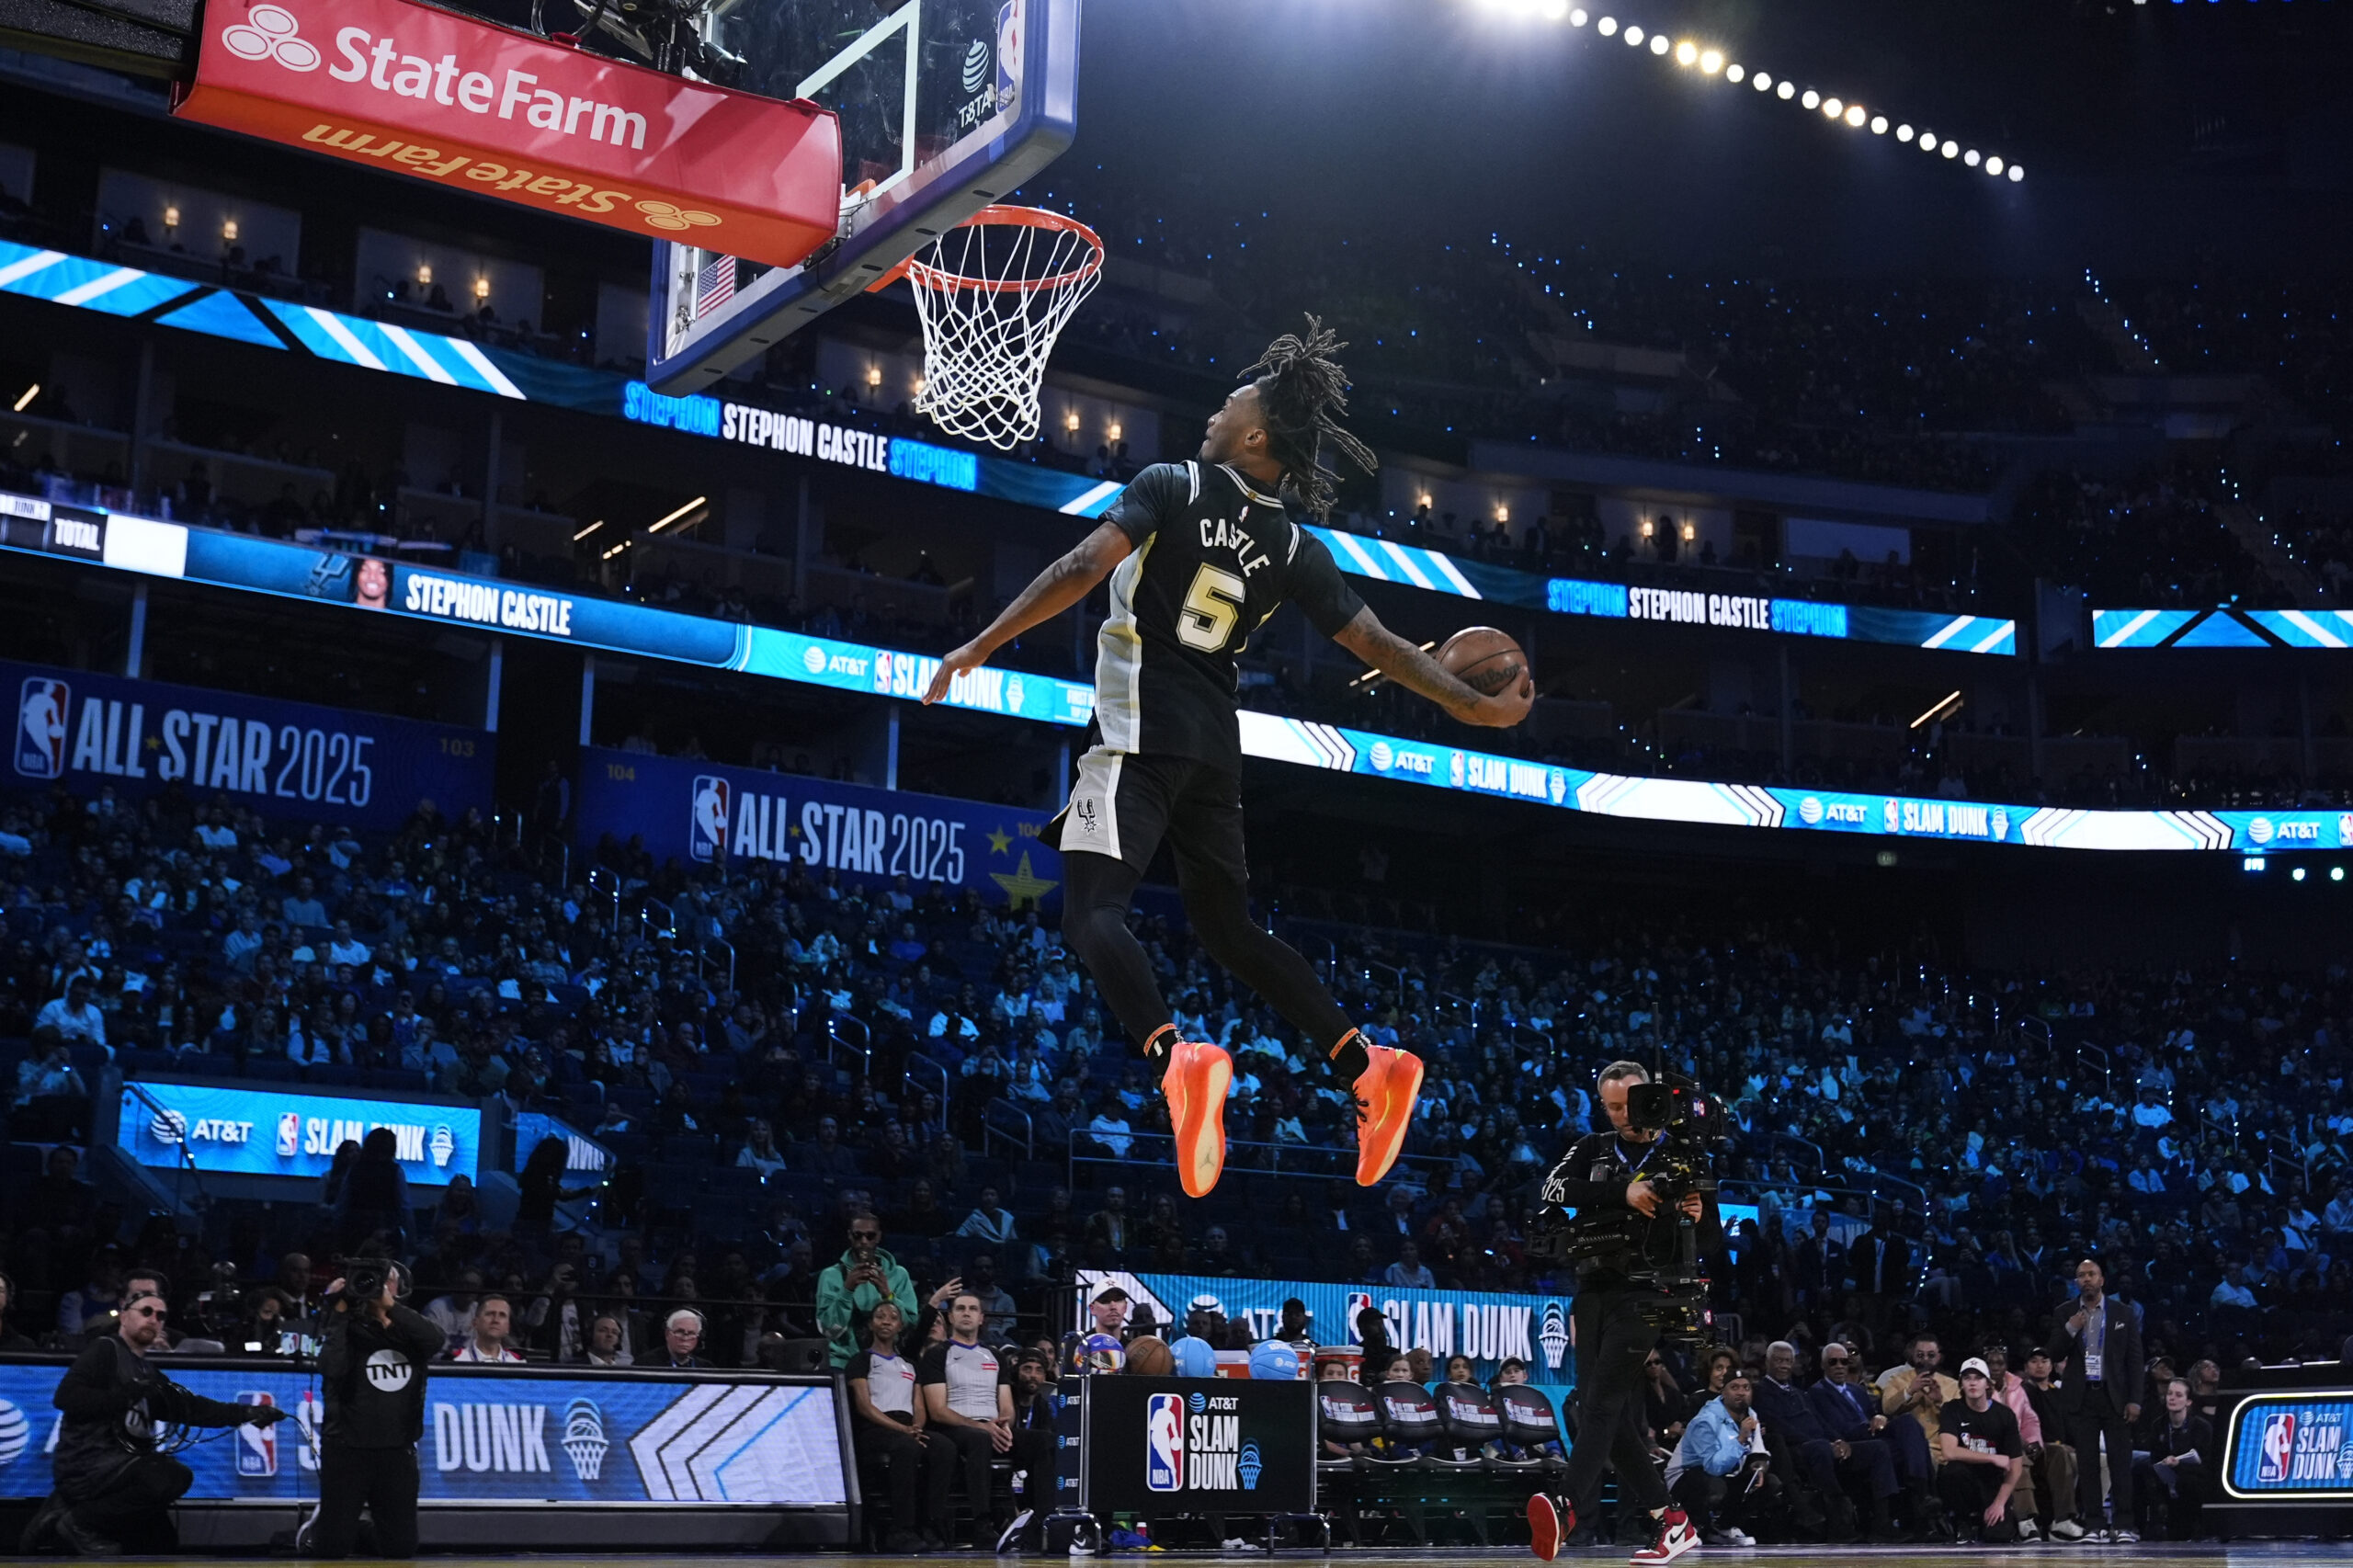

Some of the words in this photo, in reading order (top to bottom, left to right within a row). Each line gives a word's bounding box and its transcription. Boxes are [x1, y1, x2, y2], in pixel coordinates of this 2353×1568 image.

[624, 381, 720, 437] STEPHON
[722, 403, 814, 456] STEPHON
[817, 423, 887, 472] CASTLE
[890, 437, 977, 491] STEPHON
[55, 517, 100, 551] TOTAL
[1199, 518, 1270, 578] CASTLE
[405, 574, 499, 623] STEPHON
[501, 590, 573, 635] CASTLE
[1176, 562, 1246, 653] 5
[1548, 578, 1627, 618] STEPHON
[1630, 586, 1706, 624] STEPHON
[1709, 595, 1769, 630] CASTLE
[1771, 599, 1847, 638] STEPHON
[829, 654, 869, 676] AT&T
[892, 654, 949, 701] SLA
[72, 697, 146, 778] ALL
[159, 709, 271, 794] STAR
[276, 724, 374, 808] 2025
[439, 737, 475, 757] 103
[607, 764, 636, 781] 104
[1394, 751, 1436, 774] AT&T
[1468, 756, 1506, 791] SLAM
[1510, 763, 1548, 799] DUNK
[1825, 803, 1868, 823] AT&T
[1903, 801, 1945, 834] SLAM
[1948, 806, 1989, 836] DUNK
[2277, 822, 2320, 839] AT&T
[734, 792, 790, 862] ALL
[799, 801, 884, 874] STAR
[891, 812, 966, 884] 2025
[191, 1119, 254, 1142] AT&T
[370, 1121, 426, 1162] NK
[1381, 1300, 1454, 1359] SLAM
[1464, 1302, 1533, 1361] DUNK
[368, 1363, 411, 1381] TNT
[1067, 1396, 1081, 1405] AT&T
[1208, 1397, 1239, 1410] AT&T
[1189, 1415, 1239, 1452] SLAM
[2315, 1413, 2343, 1424] AT&T
[433, 1403, 551, 1472] DUNK
[1066, 1437, 1080, 1446] AT&T
[2295, 1426, 2342, 1453] SLAM
[1065, 1478, 1079, 1487] AT&T
[1153, 1469, 1170, 1484] NBA
[1188, 1453, 1239, 1490] DUNK
[2261, 1466, 2276, 1477] NBA
[2292, 1452, 2338, 1480] DUNK
